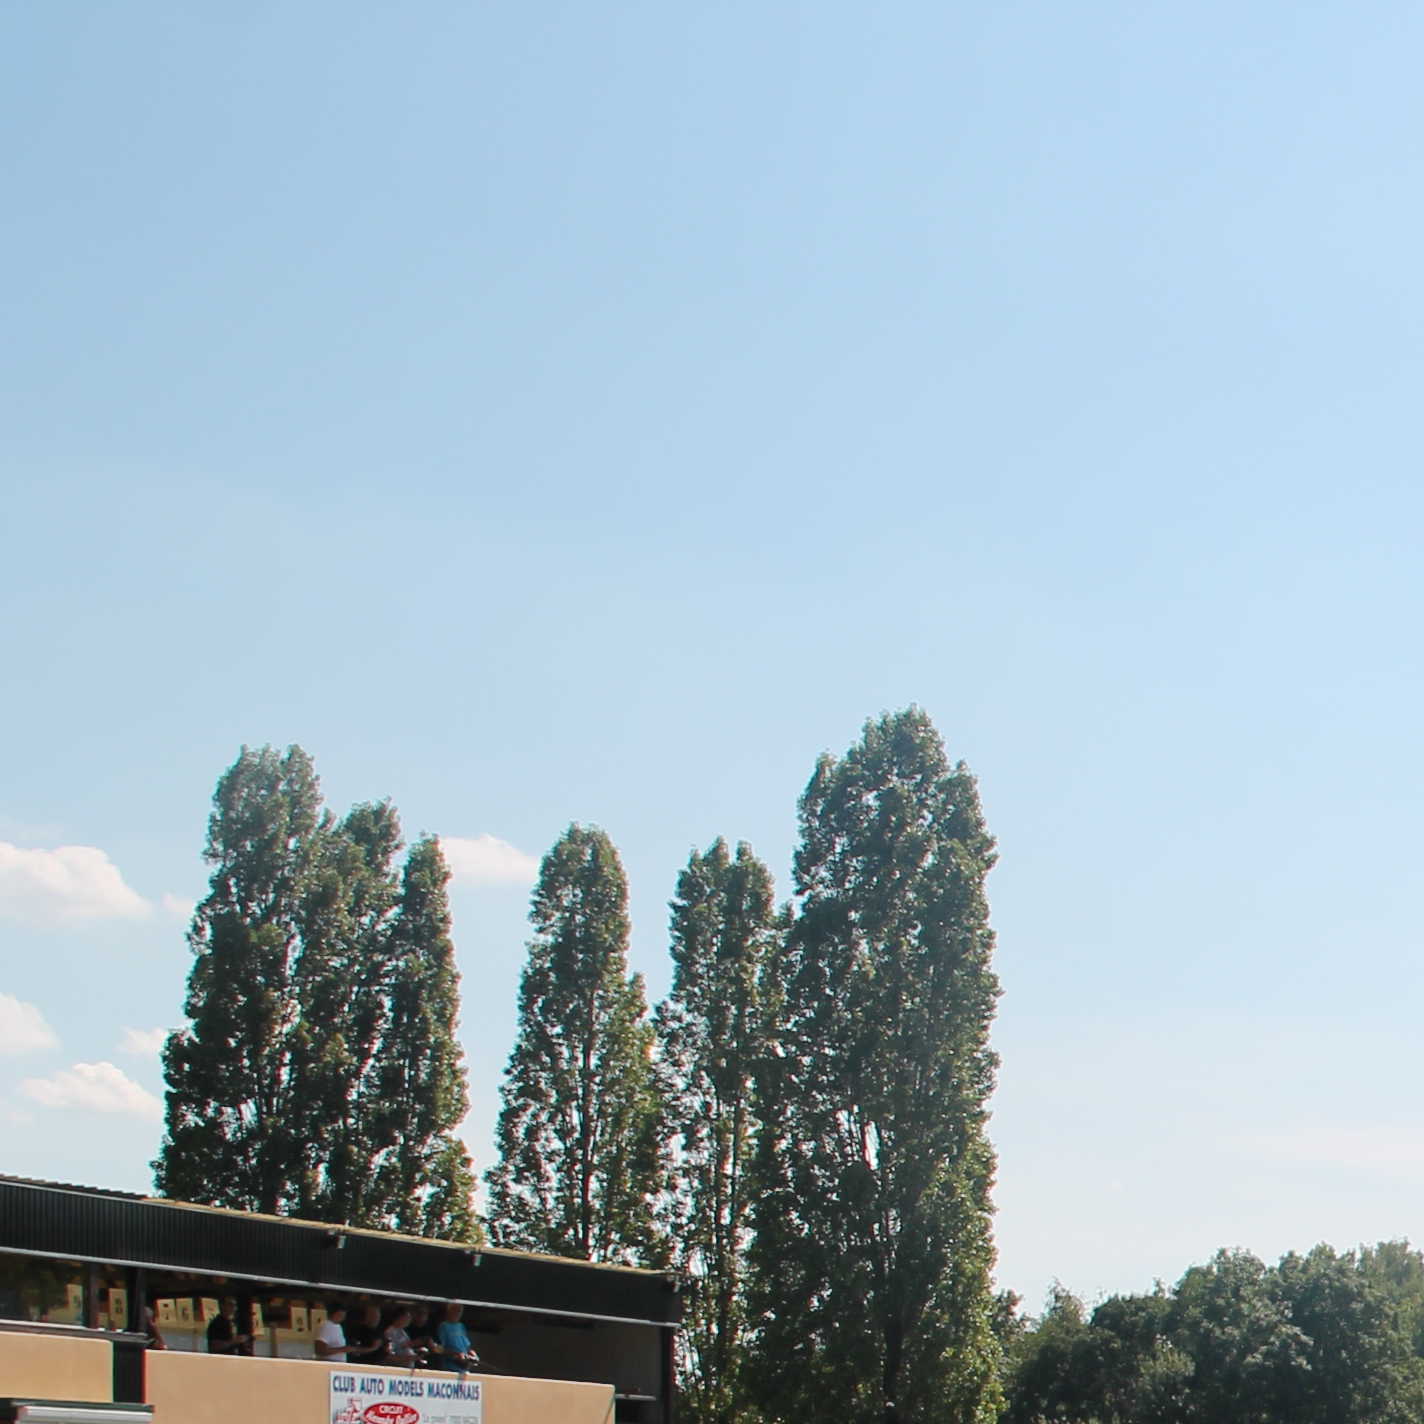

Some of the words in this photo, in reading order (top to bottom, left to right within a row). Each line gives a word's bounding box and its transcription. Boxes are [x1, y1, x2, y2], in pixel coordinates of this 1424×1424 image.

[333, 1375, 355, 1393] CLUB
[360, 1377, 385, 1395] AUTO
[388, 1379, 424, 1397] MODELS
